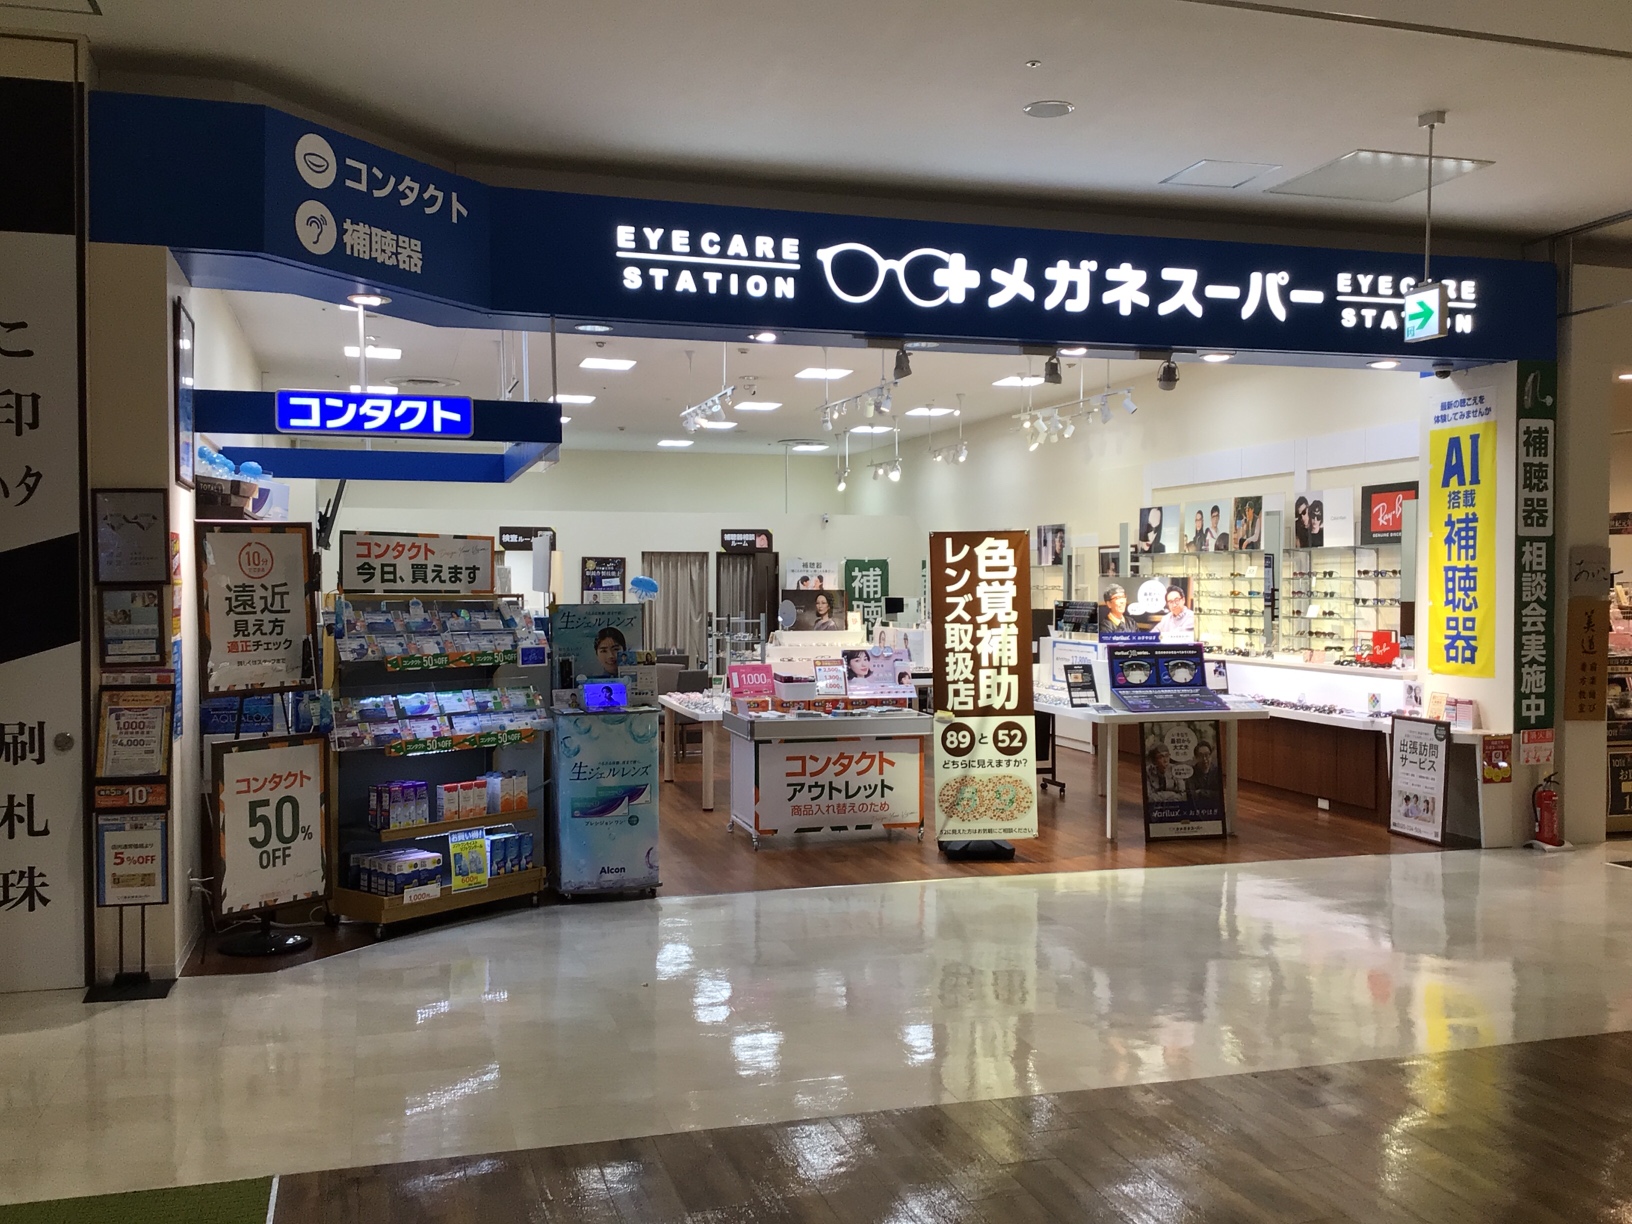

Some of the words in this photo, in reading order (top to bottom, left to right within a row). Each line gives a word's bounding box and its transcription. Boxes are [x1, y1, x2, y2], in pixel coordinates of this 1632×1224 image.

[344, 157, 469, 224] コンタクト
[343, 219, 424, 275] 補聴器
[616, 225, 800, 260] EYECARE
[623, 267, 796, 300] STATION
[988, 257, 1325, 322] メガネスーパー
[1336, 272, 1477, 300] EYECRE
[1340, 307, 1473, 334] STAN
[288, 395, 462, 432] コンタクト
[1433, 407, 1492, 424] 体験してみませんか
[1441, 433, 1481, 488] AI
[1522, 426, 1549, 528] 補聴器
[1447, 489, 1476, 510] 搭載
[246, 550, 268, 567] 10分
[355, 541, 436, 561] コンタクト
[356, 562, 481, 584] 今日、買えます
[225, 582, 291, 616] 遠近
[1443, 512, 1479, 665] 補聴器
[233, 618, 285, 638] 見え方
[558, 611, 637, 630] 生ジェルレンズ
[945, 537, 975, 711] レンズ取扱店
[974, 537, 1019, 711] 色覚補助
[1520, 541, 1547, 725] 相談会実施中
[227, 638, 292, 654] 適正チェック
[402, 657, 422, 667] コンタクト
[475, 655, 493, 663] コンタクト
[406, 743, 425, 751] コンタクト
[946, 730, 971, 749] 89
[978, 733, 989, 744] と
[997, 729, 1023, 748] 52
[1399, 738, 1439, 759] 出張訪問
[569, 761, 652, 781] 生ジェルレンズ
[785, 751, 896, 778] コンタクト
[942, 759, 1028, 769] どちらに見えますか?
[1399, 754, 1437, 772] サービス
[236, 770, 311, 795] コンタクト
[787, 779, 894, 802] アウトレット
[791, 801, 890, 817] 商品入れ替えのため
[248, 795, 313, 850] 50%
[259, 846, 292, 870] OFF
[600, 866, 626, 875] Alcon
